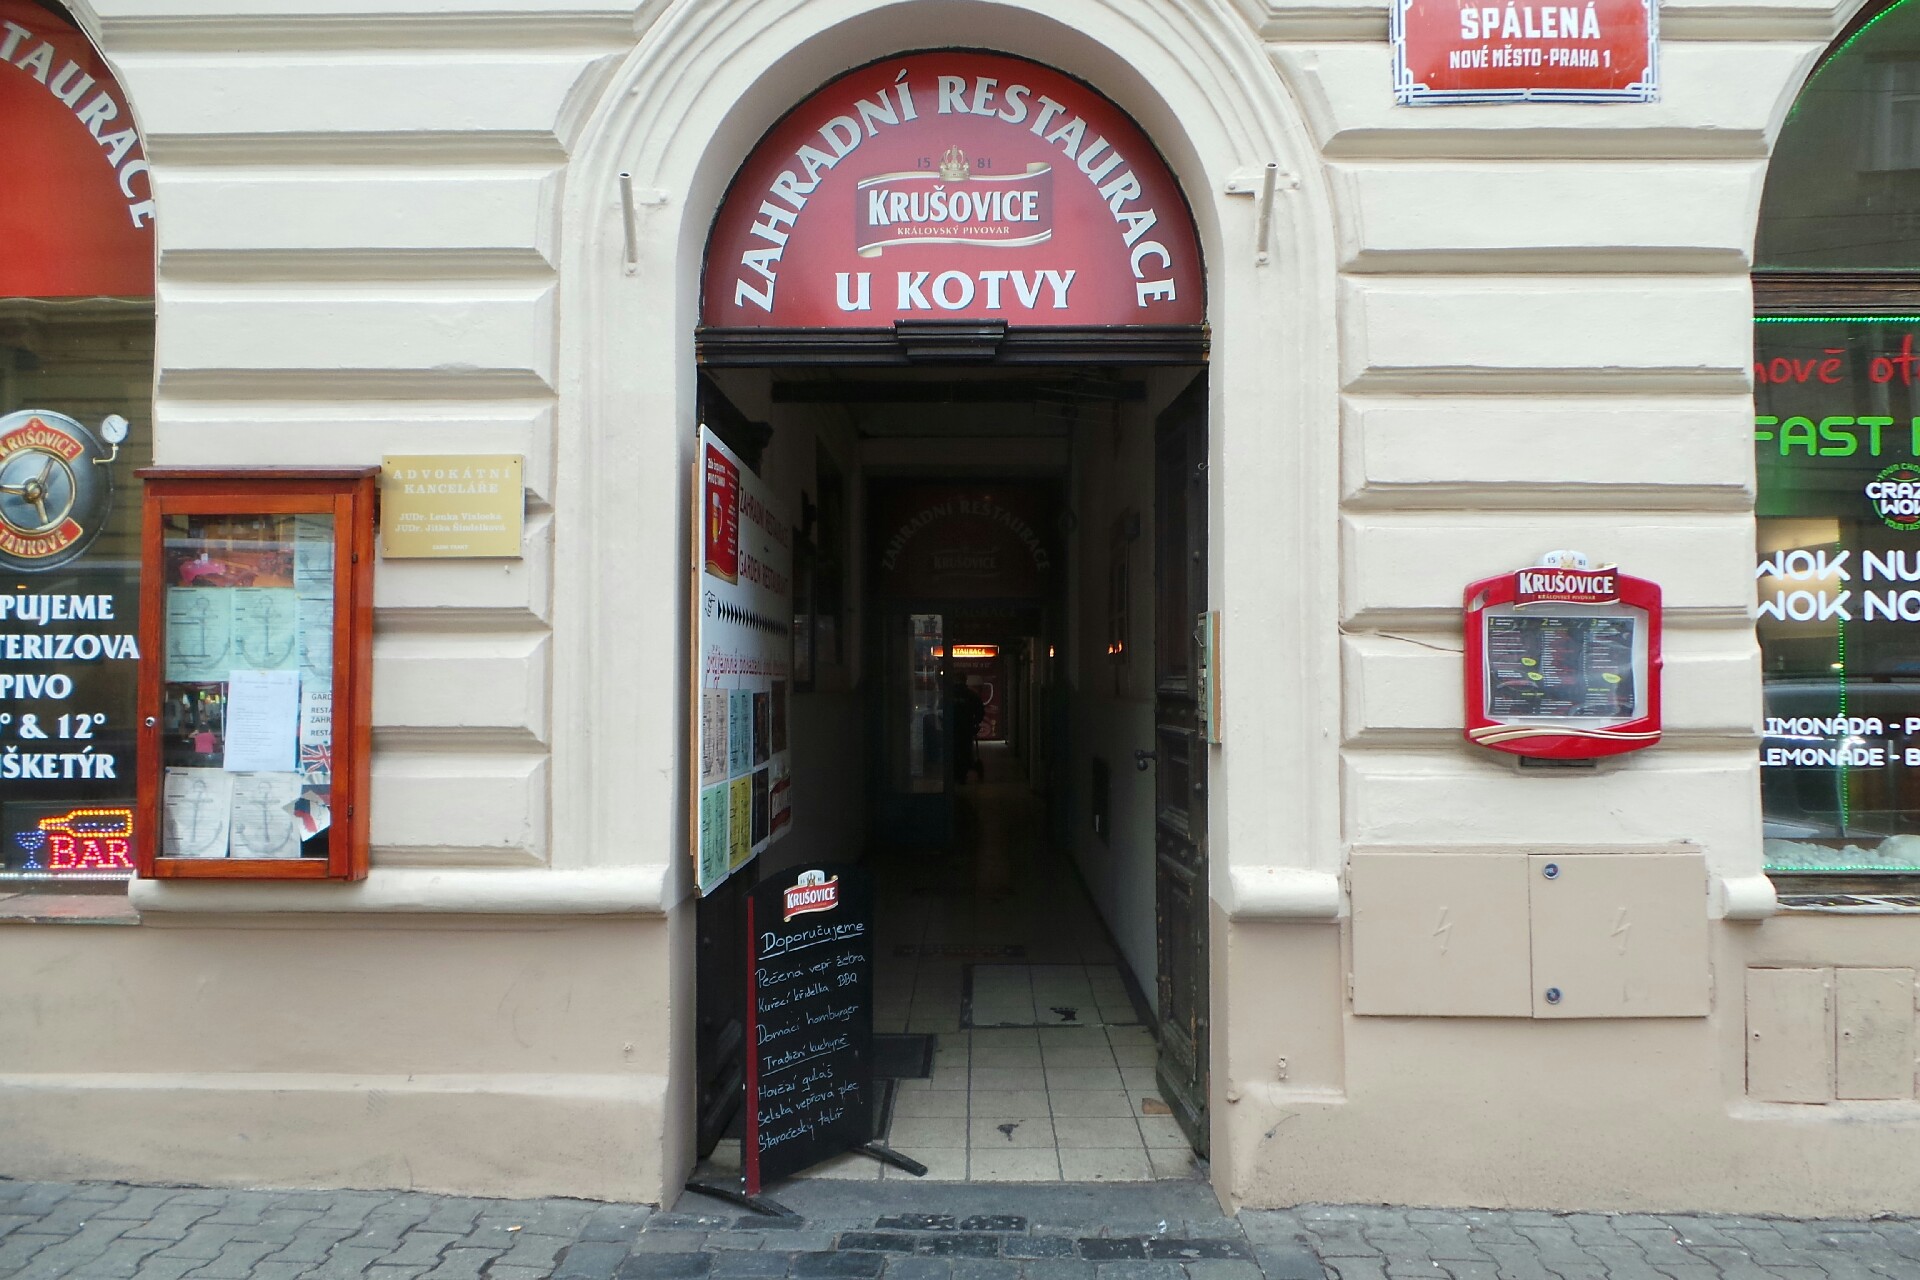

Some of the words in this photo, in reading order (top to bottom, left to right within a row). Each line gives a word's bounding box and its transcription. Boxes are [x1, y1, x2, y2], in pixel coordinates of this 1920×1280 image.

[1460, 1, 1601, 39] SPÁLENÁ
[1450, 45, 1489, 69] NOVÉ
[1603, 50, 1611, 68] 1
[917, 157, 931, 169] 15
[977, 157, 992, 169] 81
[735, 68, 918, 313] ZAHRADNÍ
[938, 74, 1176, 308] RESTAURACE
[869, 185, 1039, 226] KRUŠOVICE
[897, 224, 959, 236] KRÁLOVSKÝ
[963, 225, 1010, 235] PIVOVAR
[835, 272, 871, 311] U
[897, 269, 1075, 311] KOTVY
[393, 466, 511, 480] ADVOKÁTNÍ
[404, 481, 499, 494] KANCELÁŘE
[1755, 549, 1851, 581] WOK
[1519, 571, 1614, 594] KRUŠOVICE
[1757, 590, 1851, 622] WOK
[19, 713, 49, 739] &
[58, 712, 106, 739] 12°
[49, 834, 134, 869] BAR
[787, 888, 836, 909] KRUŠOVICE
[760, 922, 865, 954] Doporučujeme
[755, 964, 804, 989] Pečená
[758, 991, 791, 1013] Kuřecí
[836, 972, 858, 988] BBQ
[805, 1004, 859, 1025] hamburger
[801, 1062, 834, 1093] guláš
[757, 1097, 794, 1128] Selská
[795, 1082, 835, 1111] vepřová
[757, 1117, 815, 1153] Staročeský
